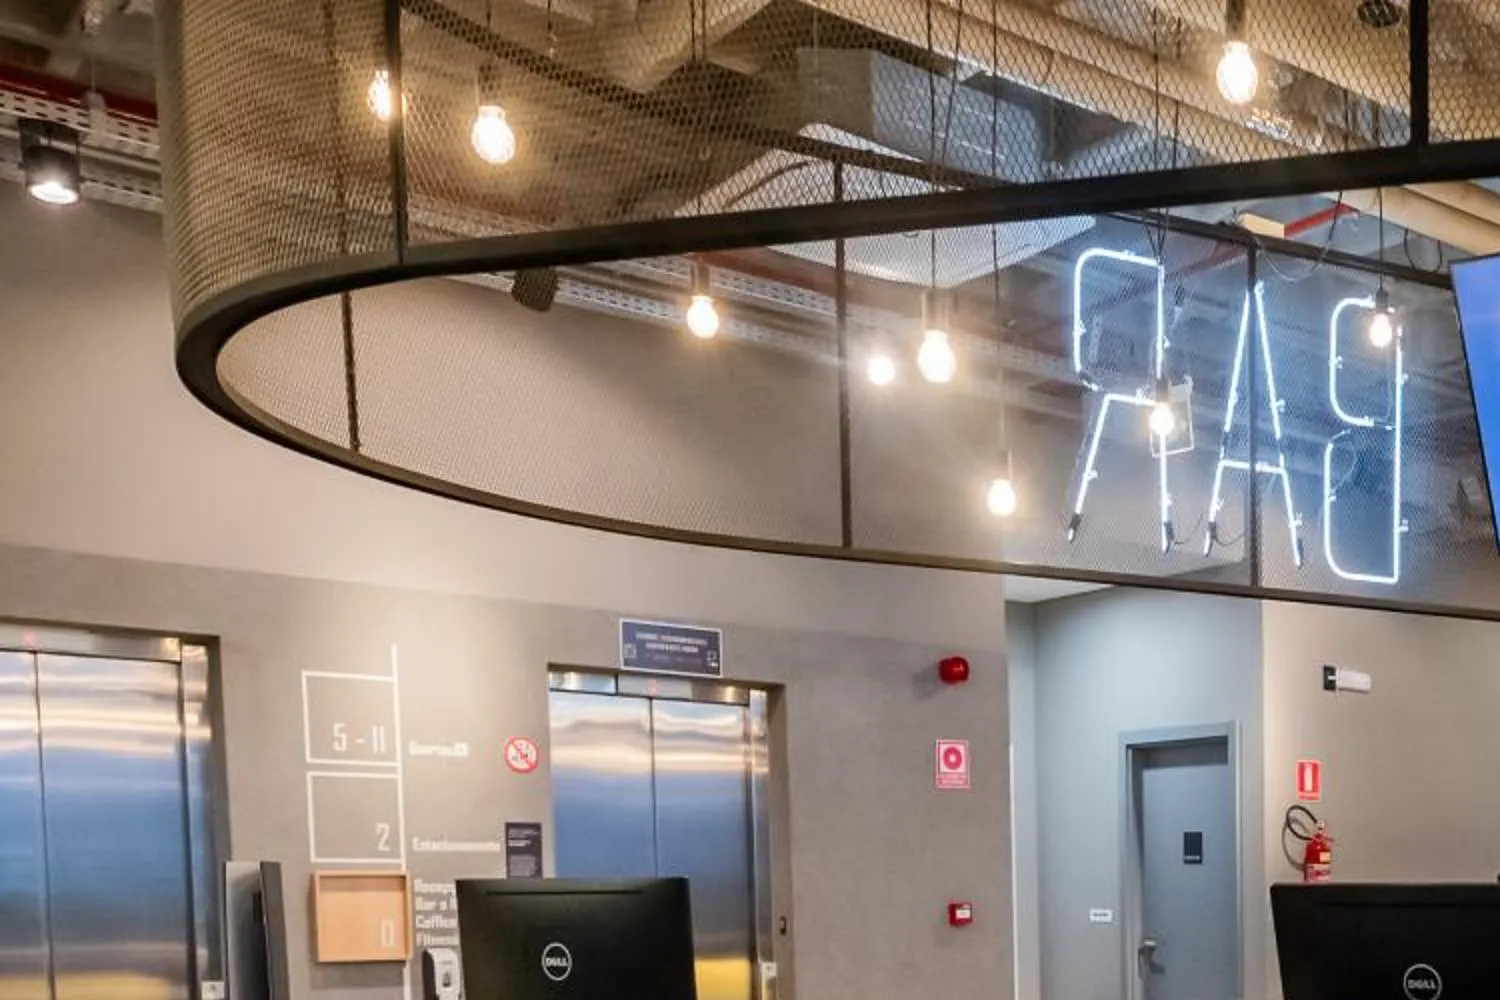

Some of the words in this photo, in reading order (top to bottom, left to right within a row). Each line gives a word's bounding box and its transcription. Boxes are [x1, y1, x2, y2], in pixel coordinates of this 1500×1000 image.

[333, 722, 348, 752] 5
[376, 822, 391, 852] 2
[381, 918, 395, 948] 0
